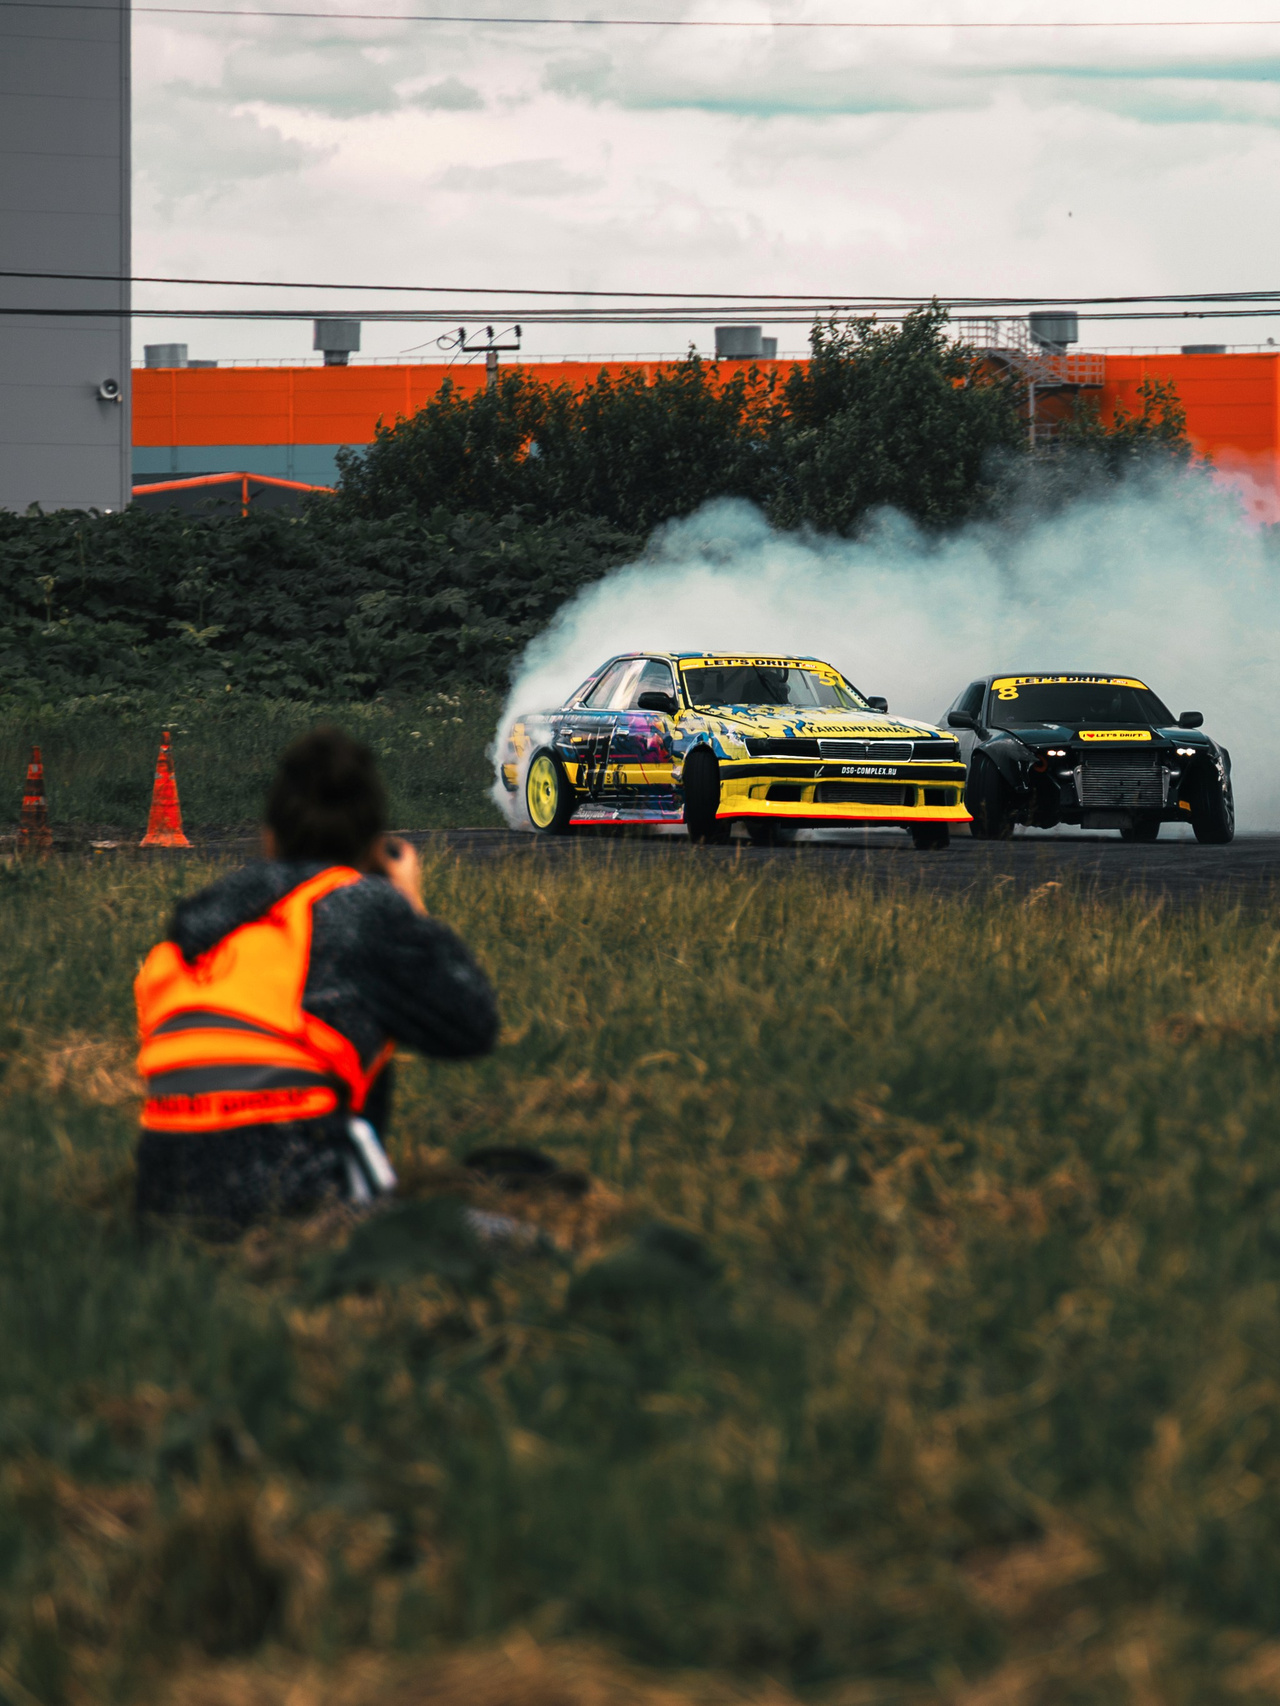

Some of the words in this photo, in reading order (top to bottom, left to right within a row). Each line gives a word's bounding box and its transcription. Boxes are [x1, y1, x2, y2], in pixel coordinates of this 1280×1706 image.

[754, 659, 802, 668] DRIFT
[1015, 676, 1060, 684] LET'S
[998, 686, 1019, 700] 8
[841, 766, 898, 776] DSG-COMPLEX.RU
